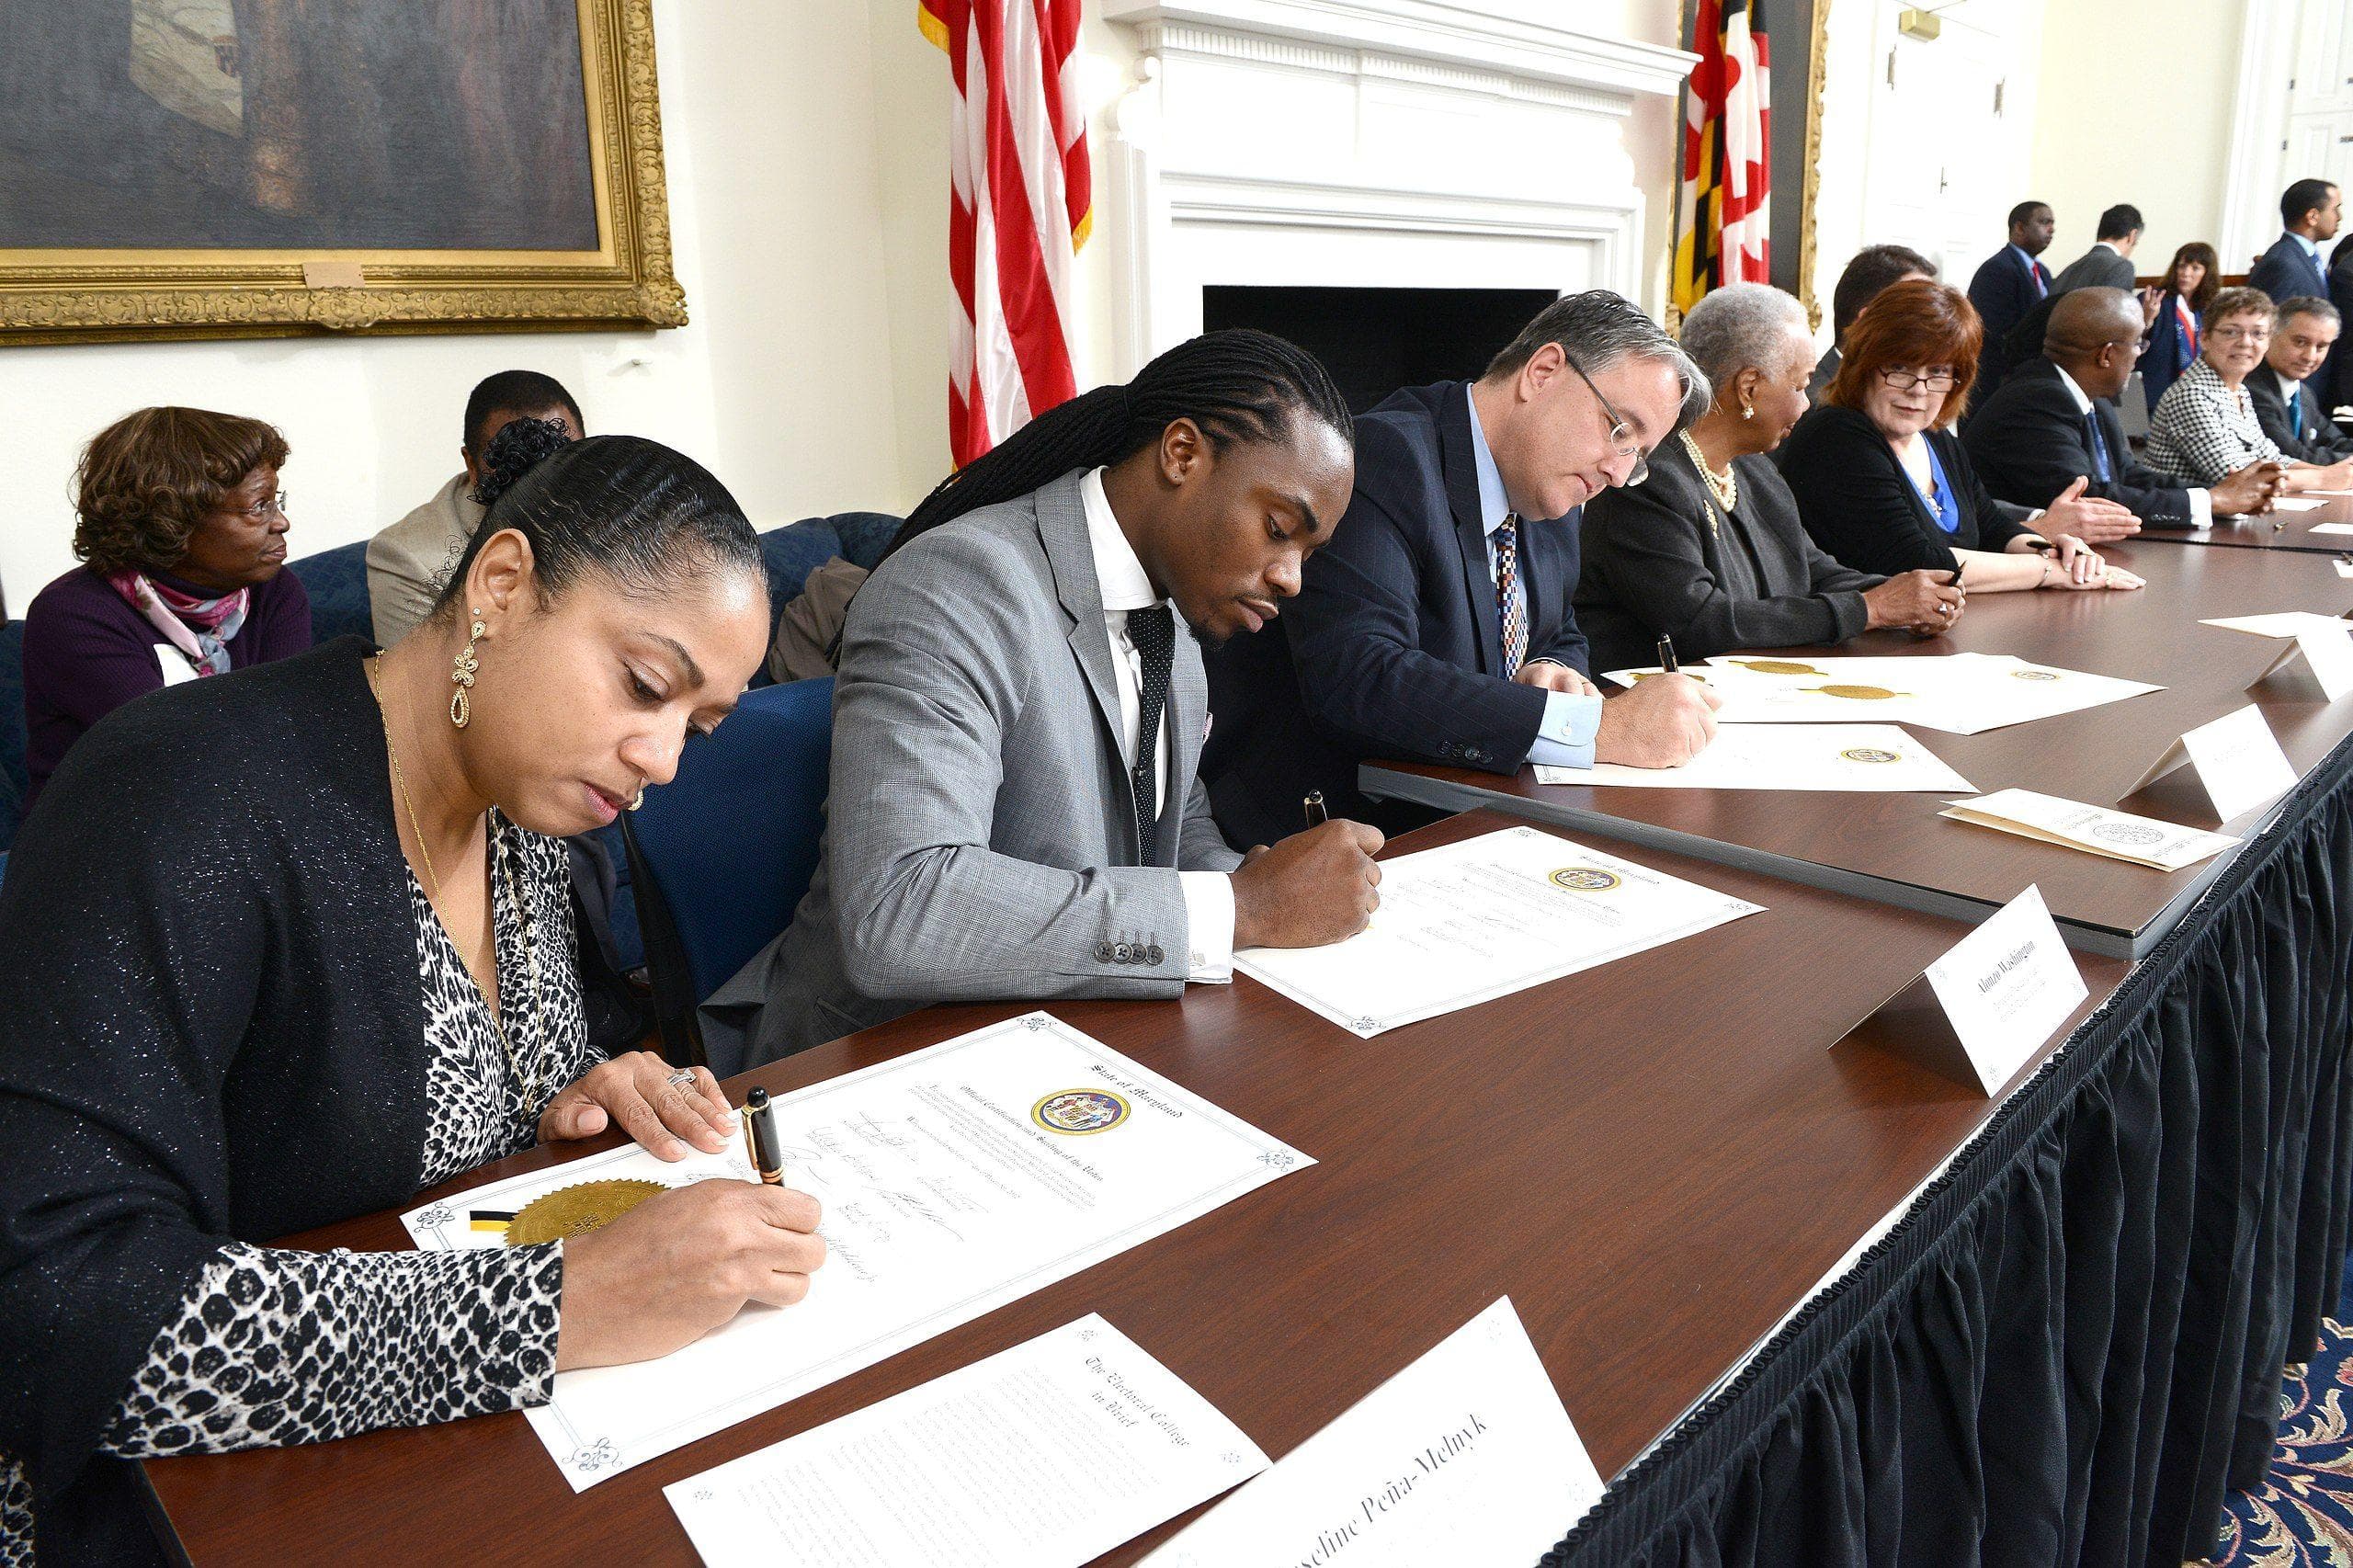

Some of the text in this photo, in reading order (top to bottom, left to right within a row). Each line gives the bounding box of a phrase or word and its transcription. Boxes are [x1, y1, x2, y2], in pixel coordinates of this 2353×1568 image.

[1978, 941, 2035, 993] Alonzo Washington
[1090, 1065, 1183, 1118] State of Maryland
[1086, 1356, 1107, 1374] The
[1107, 1371, 1155, 1413] Electoral
[1150, 1410, 1190, 1447] College
[1091, 1392, 1140, 1428] in Brief
[1295, 1518, 1358, 1568] seline
[1361, 1413, 1487, 1524] Peña-Melnyk
